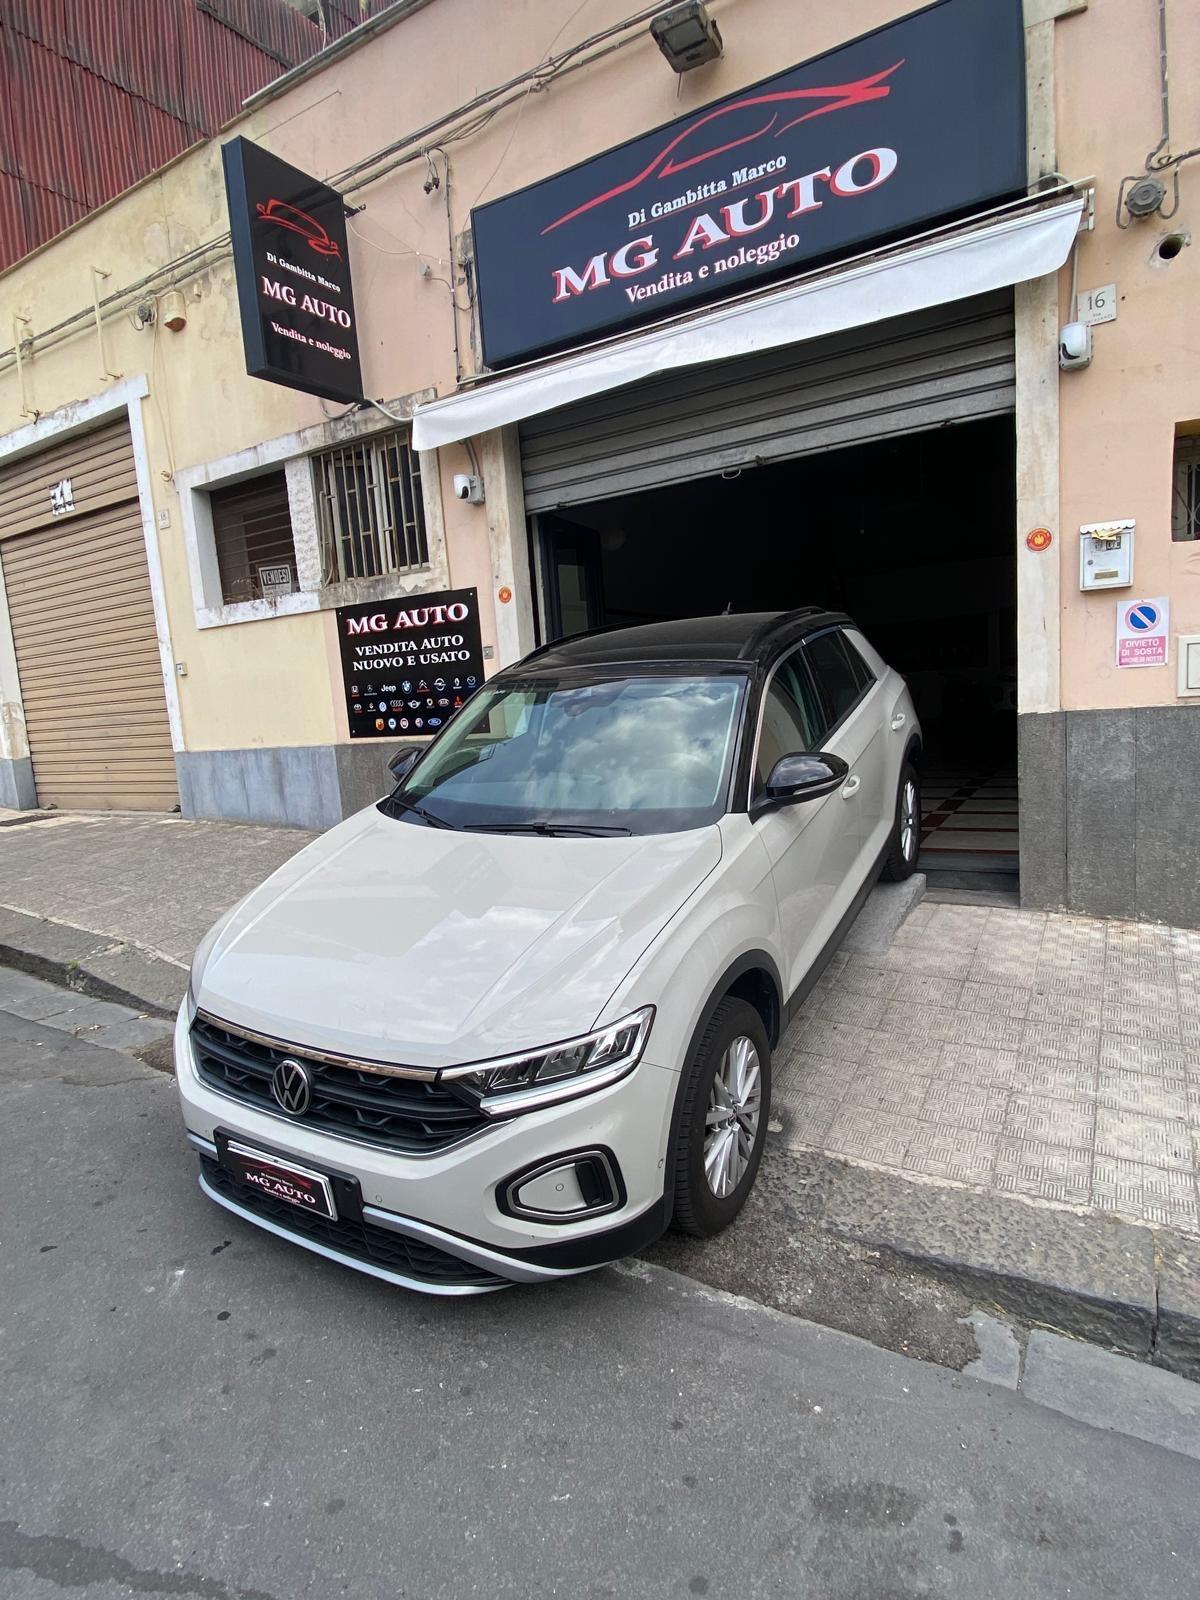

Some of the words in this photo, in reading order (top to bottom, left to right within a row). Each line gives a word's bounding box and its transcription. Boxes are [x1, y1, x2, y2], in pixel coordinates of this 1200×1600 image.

[628, 209, 646, 228] Di
[651, 181, 727, 218] Gambitta
[732, 155, 787, 187] Marco
[552, 234, 659, 304] MG
[672, 147, 898, 261] AUTO
[266, 251, 277, 264] Di
[279, 258, 317, 282] Gambitta
[317, 275, 341, 292] Marco
[625, 270, 693, 303] Vendita
[698, 265, 709, 278] e
[714, 233, 800, 274] noleggio
[261, 276, 297, 306] MG
[300, 294, 351, 328] AUTO
[1087, 291, 1105, 310] 16
[270, 321, 307, 344] Vendita
[308, 338, 314, 346] e
[316, 340, 352, 360] noleggio
[261, 569, 290, 585] VENDESI
[346, 613, 388, 636] MG
[392, 602, 469, 630] AUTO
[355, 640, 419, 657] VENDITA
[420, 634, 464, 650] AUTO
[1121, 649, 1130, 657] DI
[1134, 647, 1163, 656] SOSTA
[1125, 639, 1160, 648] DIVIETO
[353, 656, 404, 671] NUOVO
[406, 655, 416, 666] E
[419, 650, 470, 665] USATO
[381, 684, 397, 693] Jeep
[245, 1172, 270, 1187] MG
[274, 1183, 316, 1204] AUTO
